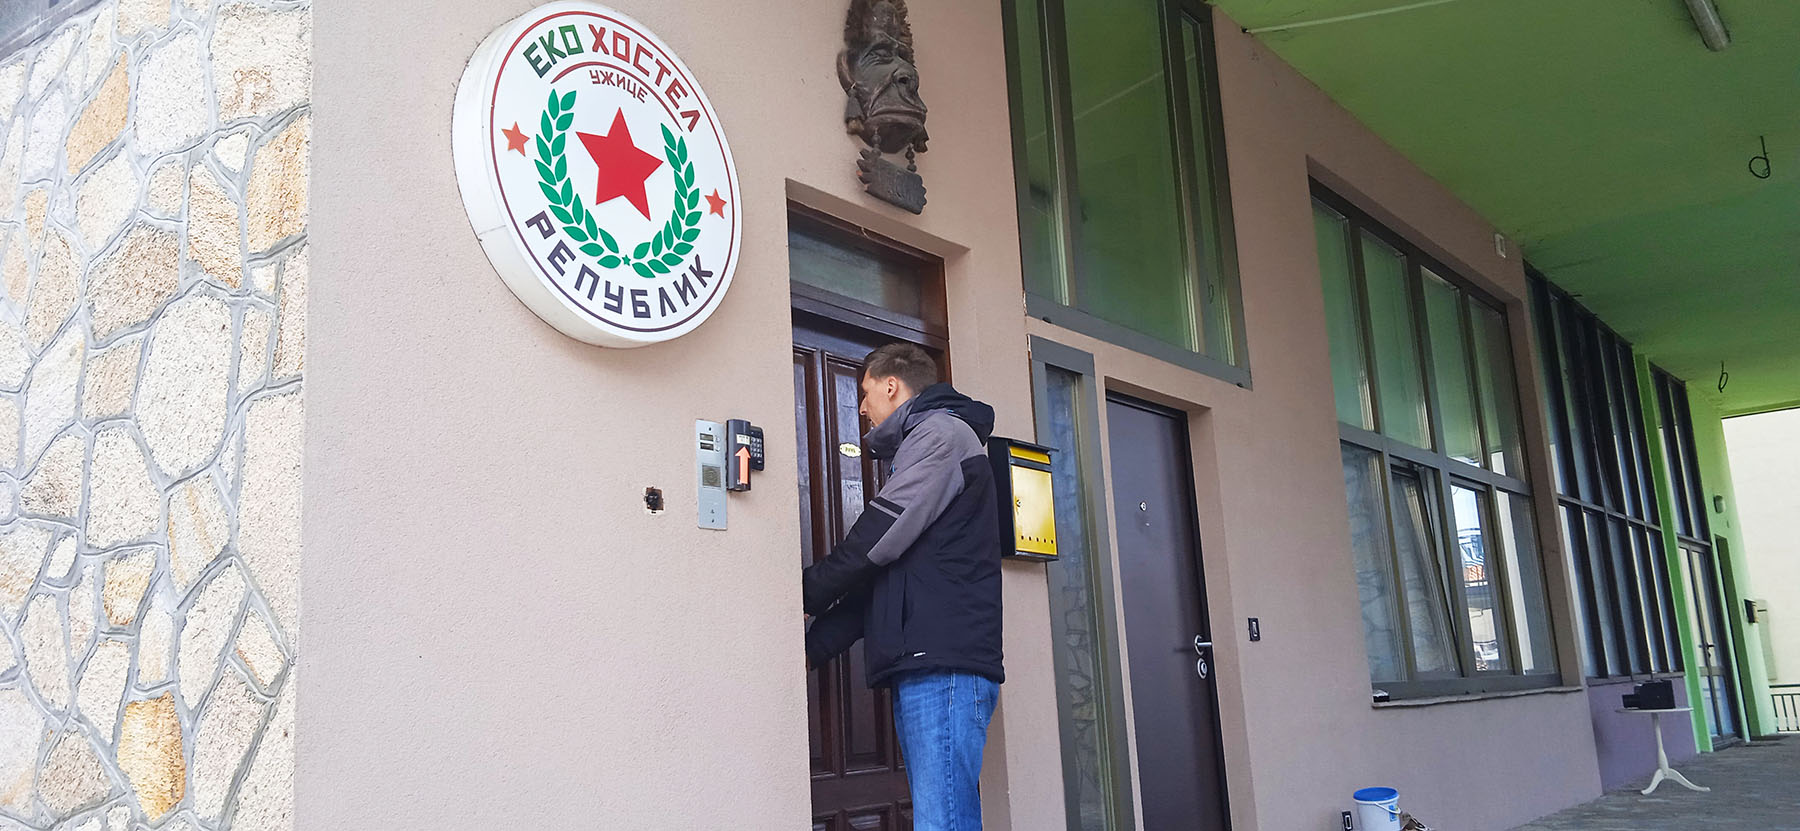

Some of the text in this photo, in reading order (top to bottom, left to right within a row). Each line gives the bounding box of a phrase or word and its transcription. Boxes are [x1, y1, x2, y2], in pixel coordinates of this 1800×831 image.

[523, 24, 701, 132] ЕКО ХОСТЕЛ
[588, 69, 648, 103] УЖИЦЕ
[525, 210, 713, 318] РЕПУБЛИК
